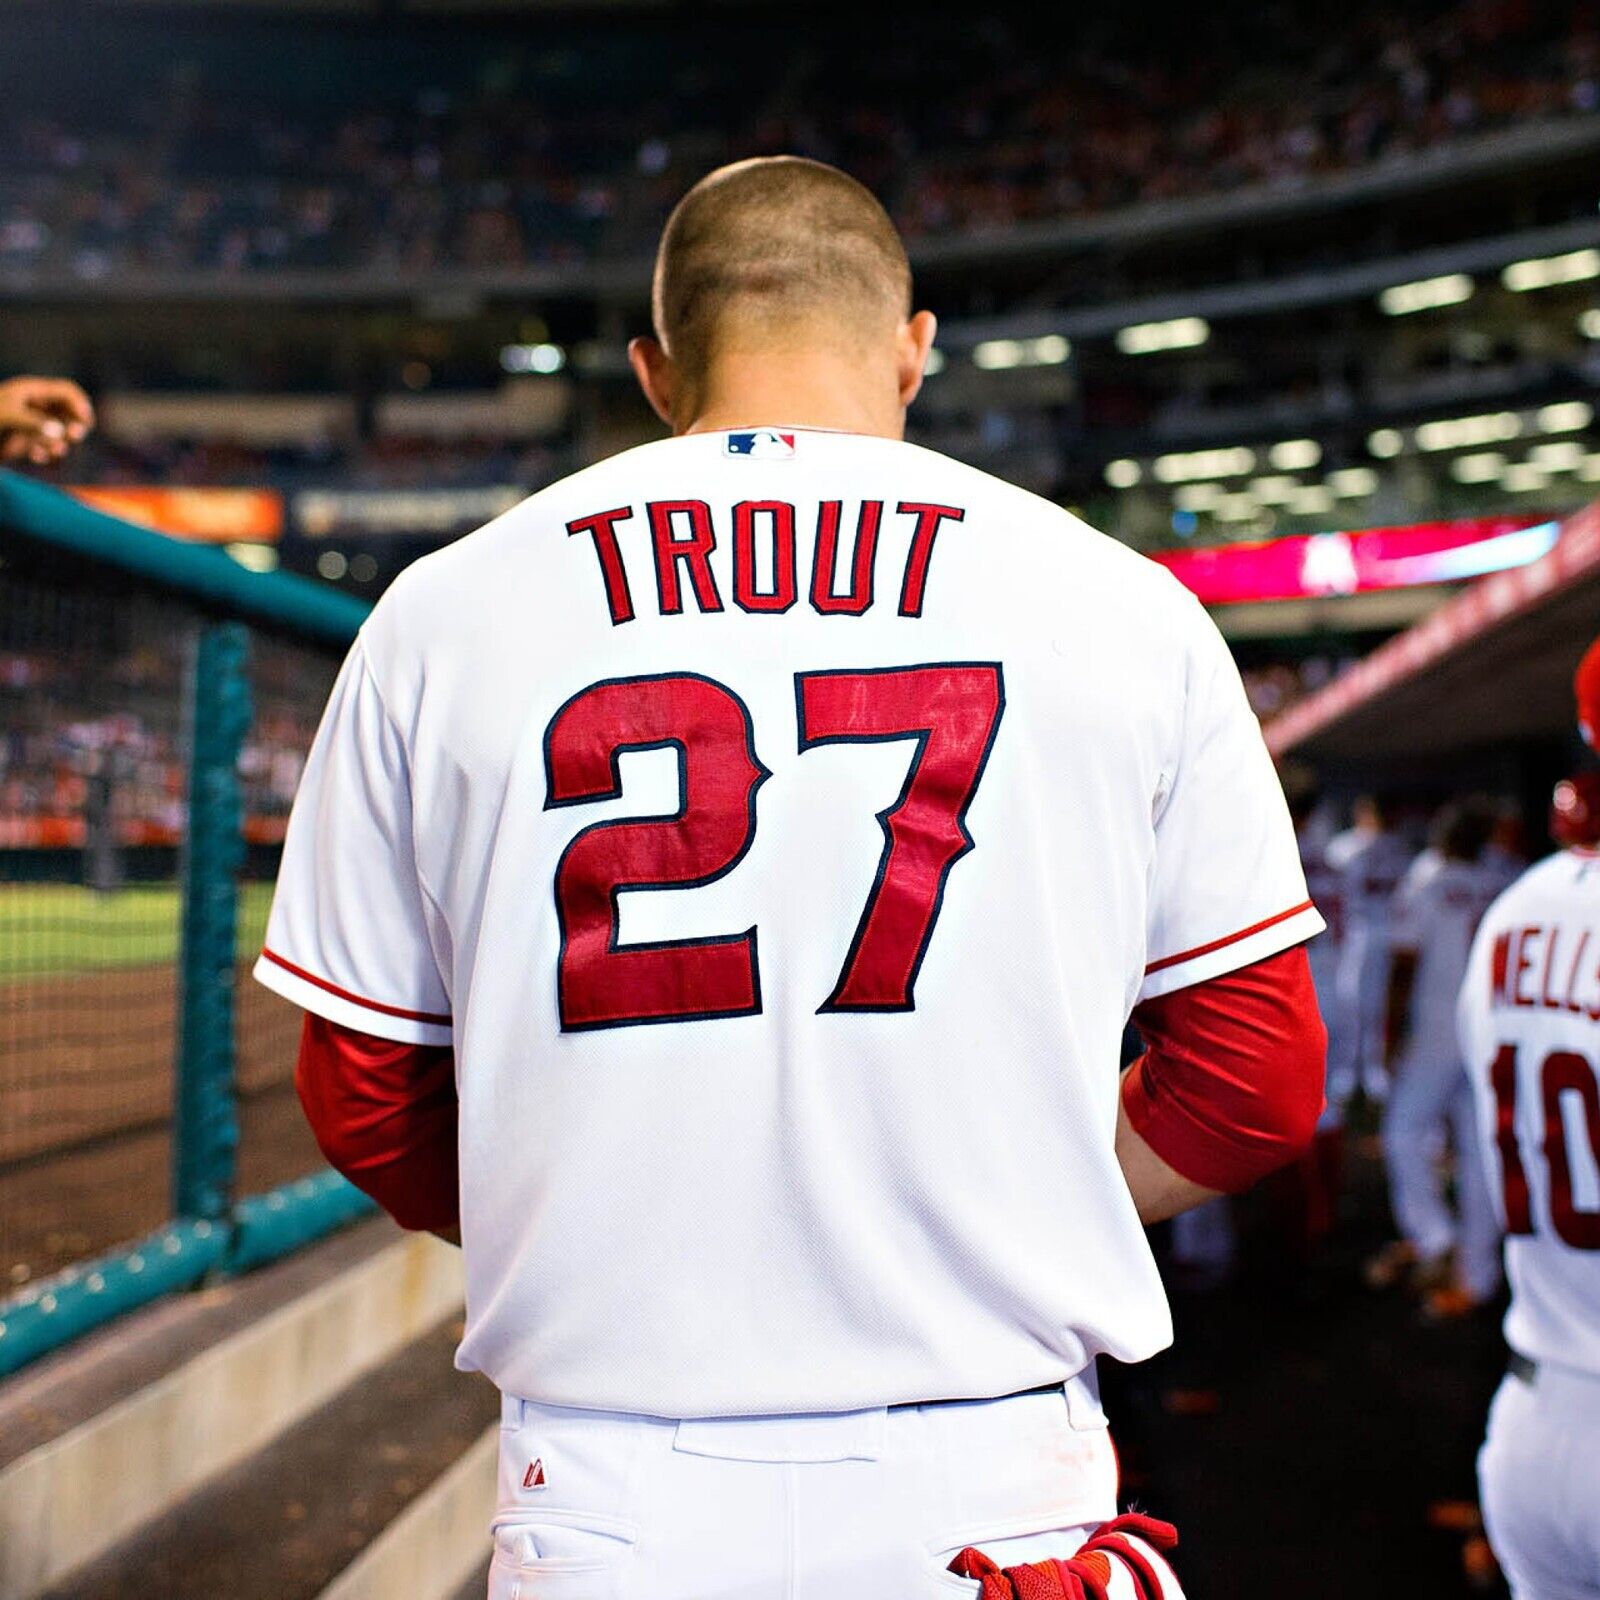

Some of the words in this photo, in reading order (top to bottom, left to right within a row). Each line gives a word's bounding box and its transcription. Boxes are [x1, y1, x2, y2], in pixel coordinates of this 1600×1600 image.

[565, 499, 965, 626] TROUT
[543, 661, 1006, 1033] 27
[1489, 1044, 1600, 1250] 10
